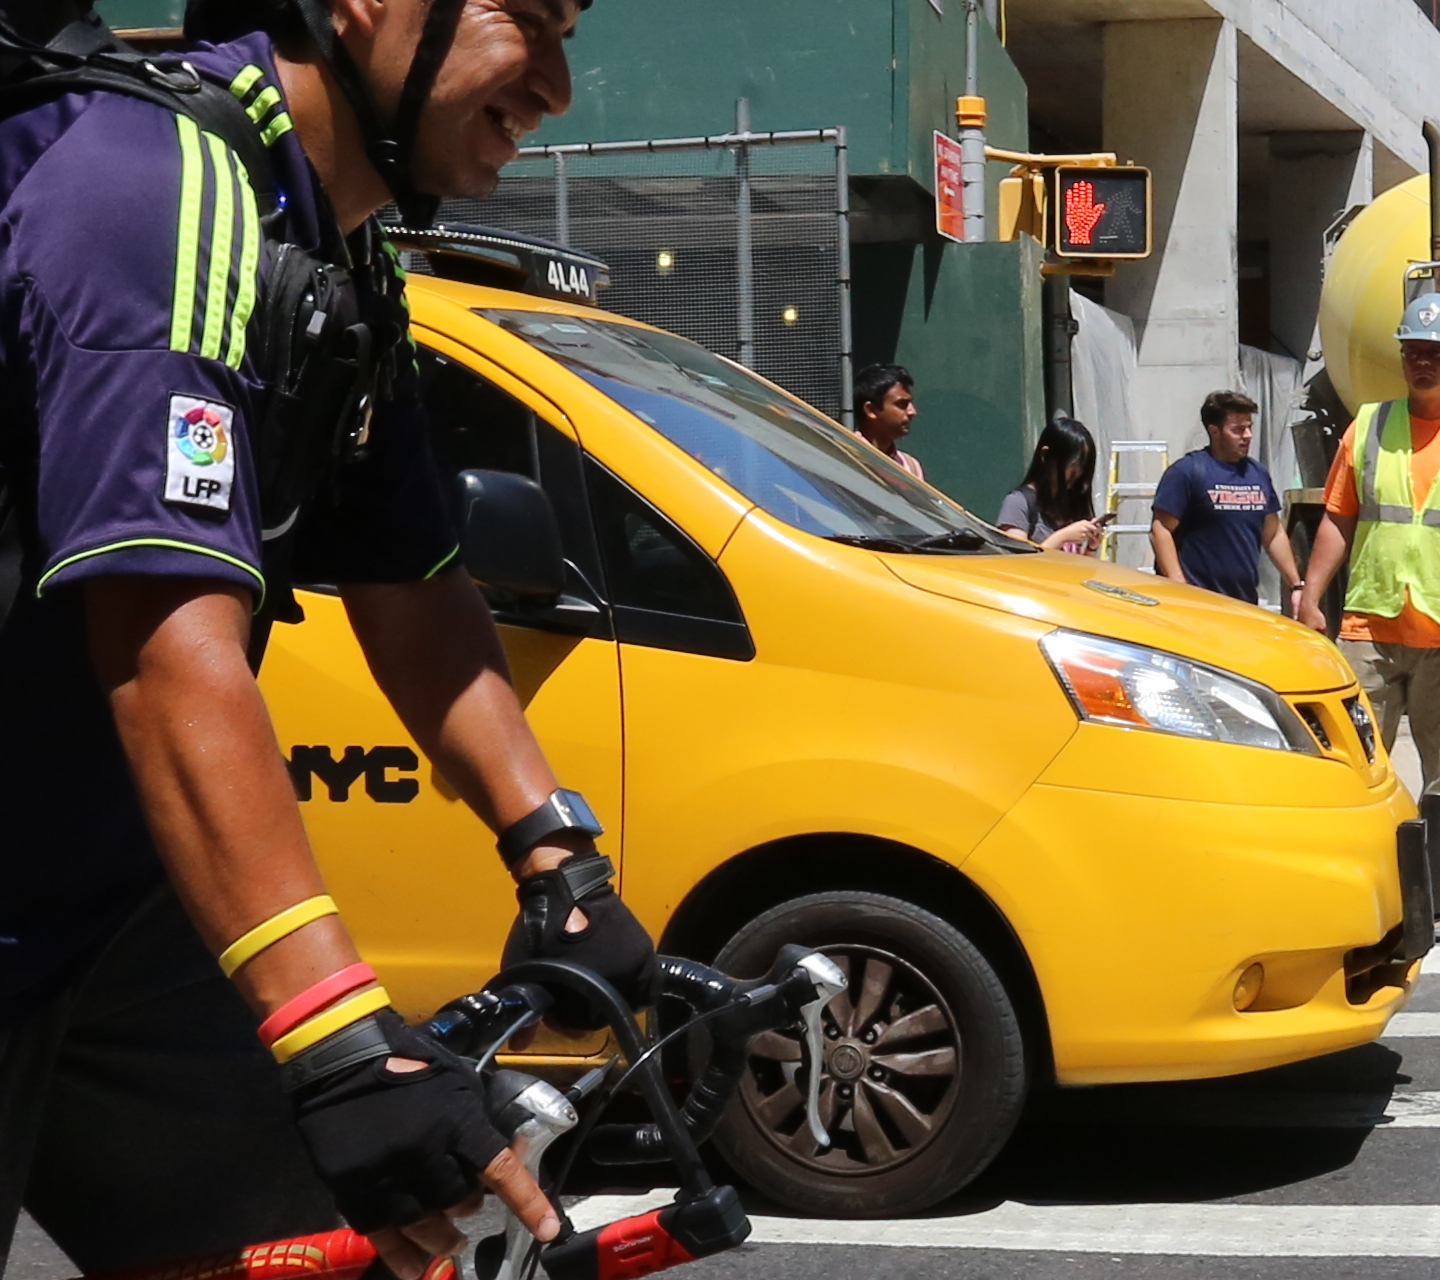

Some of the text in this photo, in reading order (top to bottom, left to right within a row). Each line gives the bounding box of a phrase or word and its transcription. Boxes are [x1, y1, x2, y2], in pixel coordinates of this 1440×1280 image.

[547, 260, 591, 298] 4L44
[182, 475, 222, 499] LFP
[1207, 489, 1267, 505] VIRGINIA
[284, 744, 420, 803] NYC
